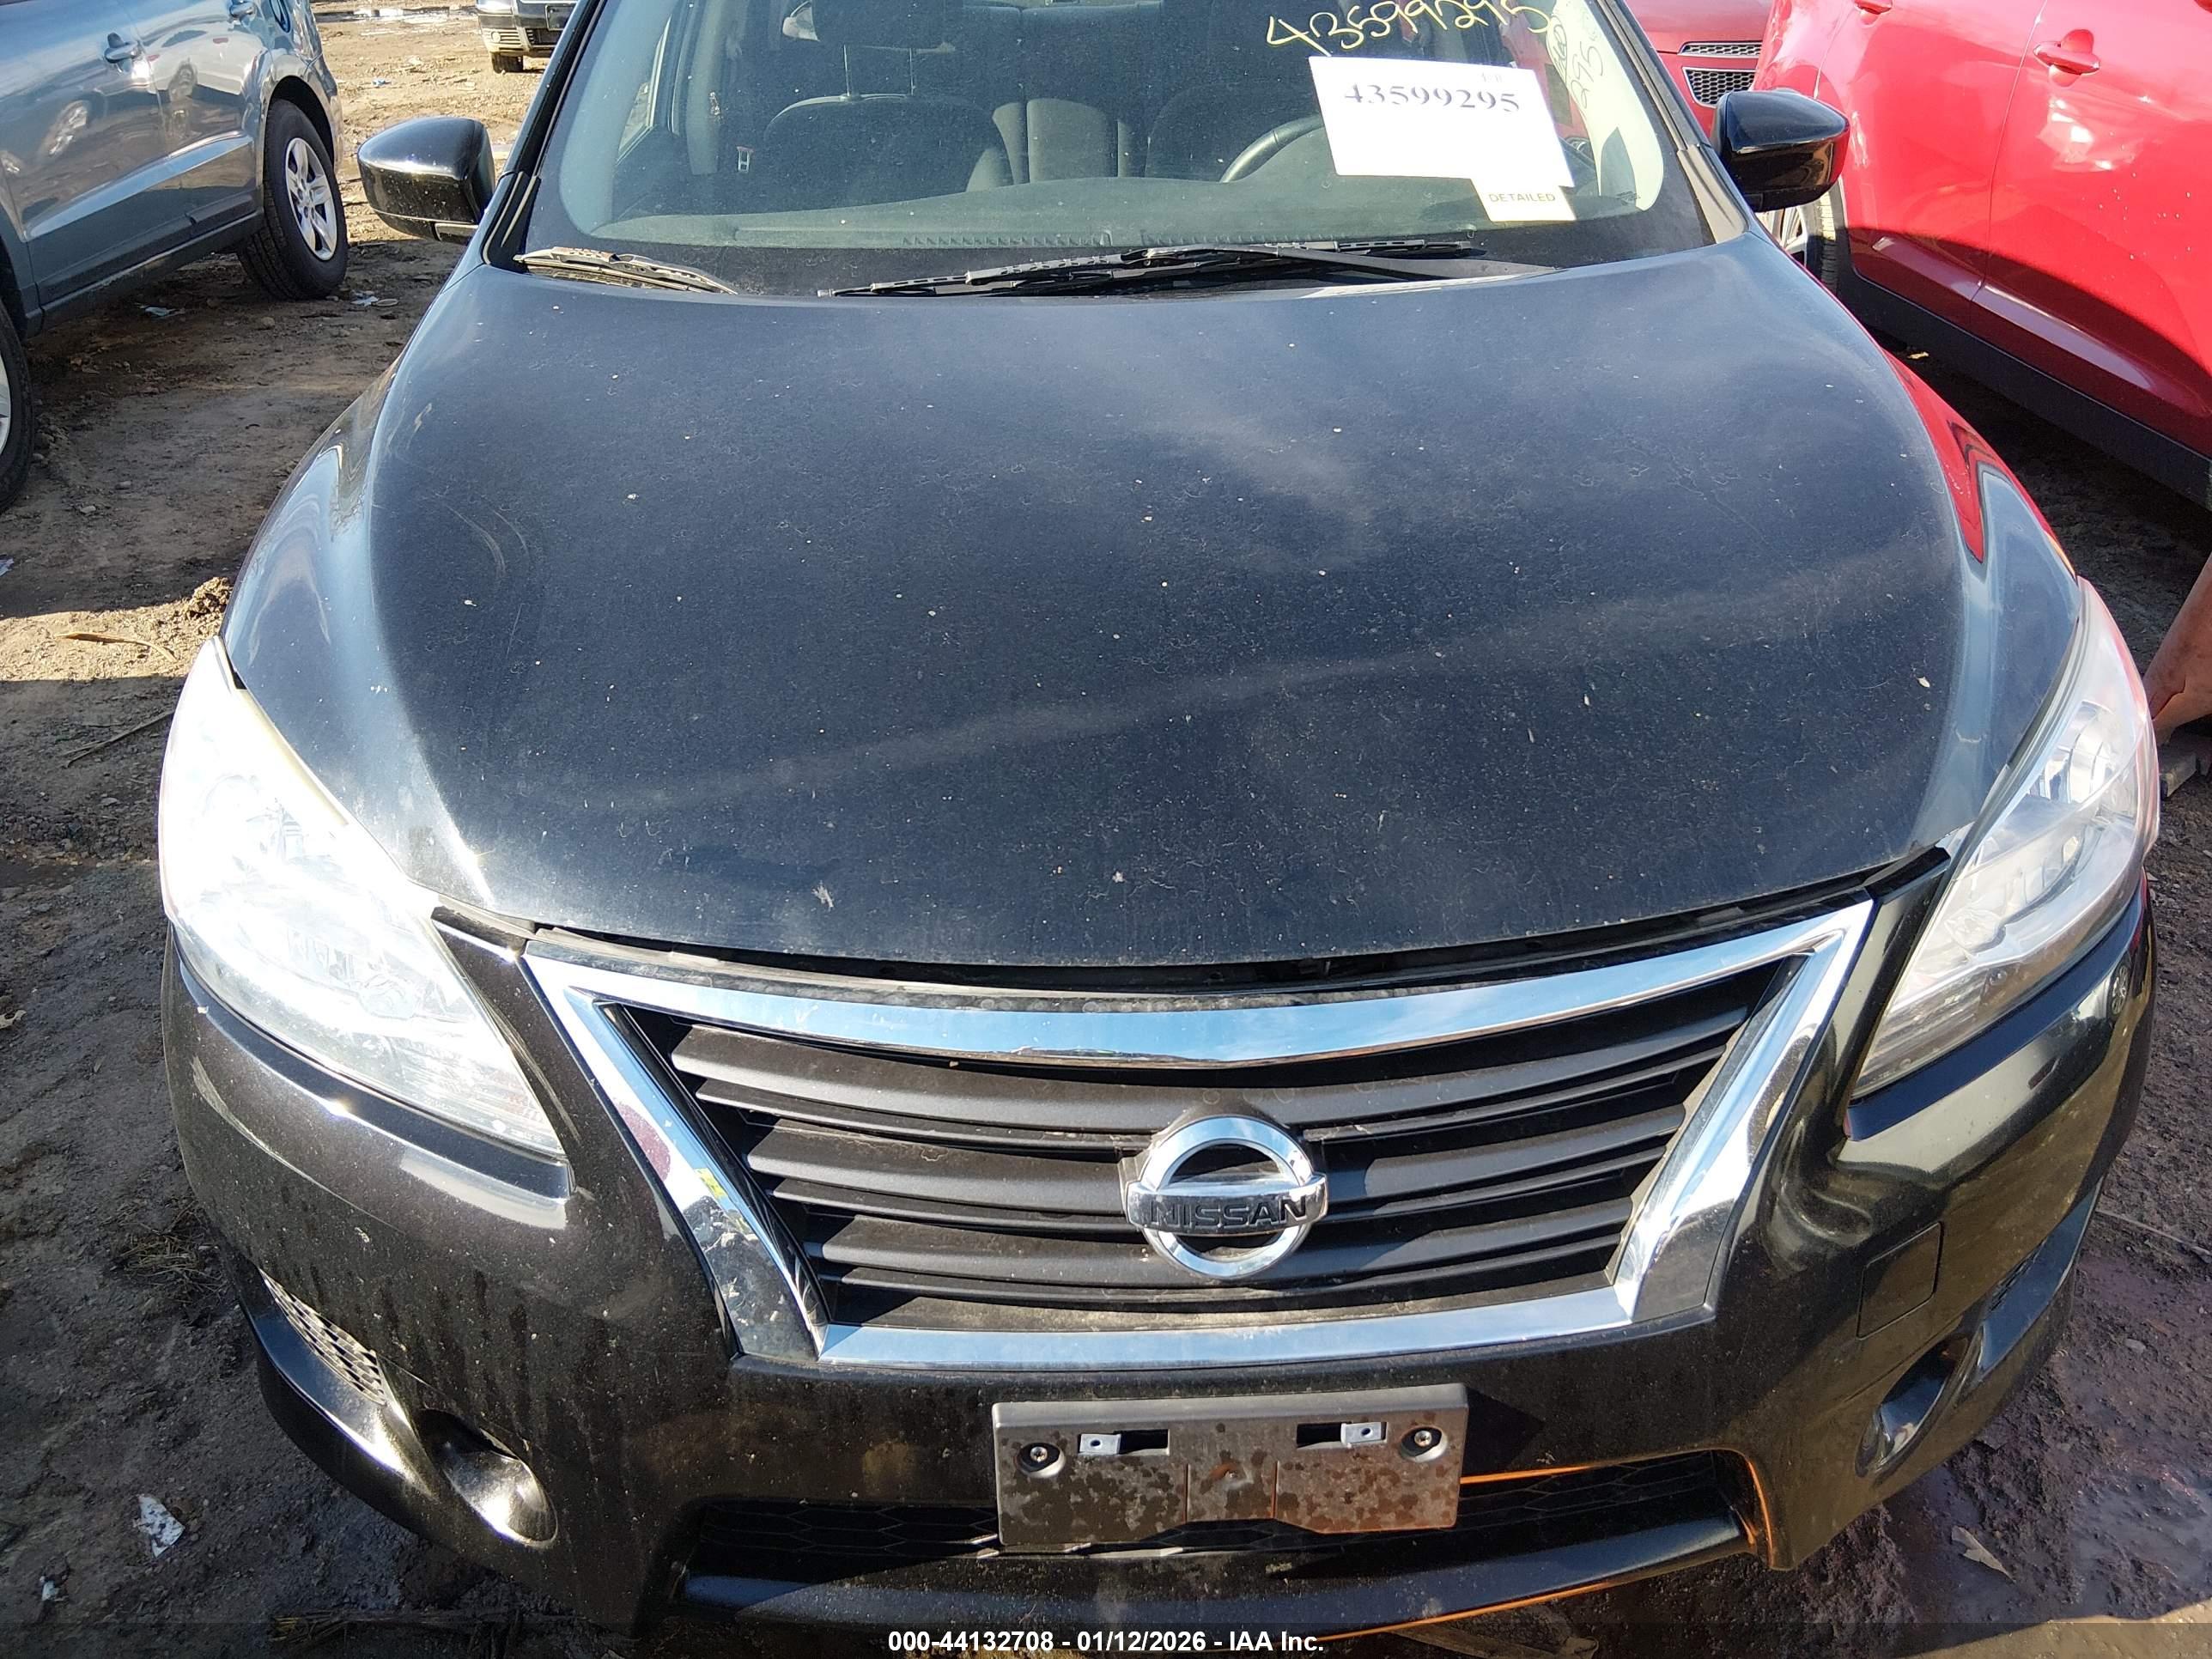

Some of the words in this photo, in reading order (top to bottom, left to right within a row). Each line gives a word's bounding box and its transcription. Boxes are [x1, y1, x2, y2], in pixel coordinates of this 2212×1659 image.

[1345, 83, 1520, 112] 43599295
[1488, 192, 1557, 203] DETAILED
[1150, 1194, 1307, 1228] NISSAN
